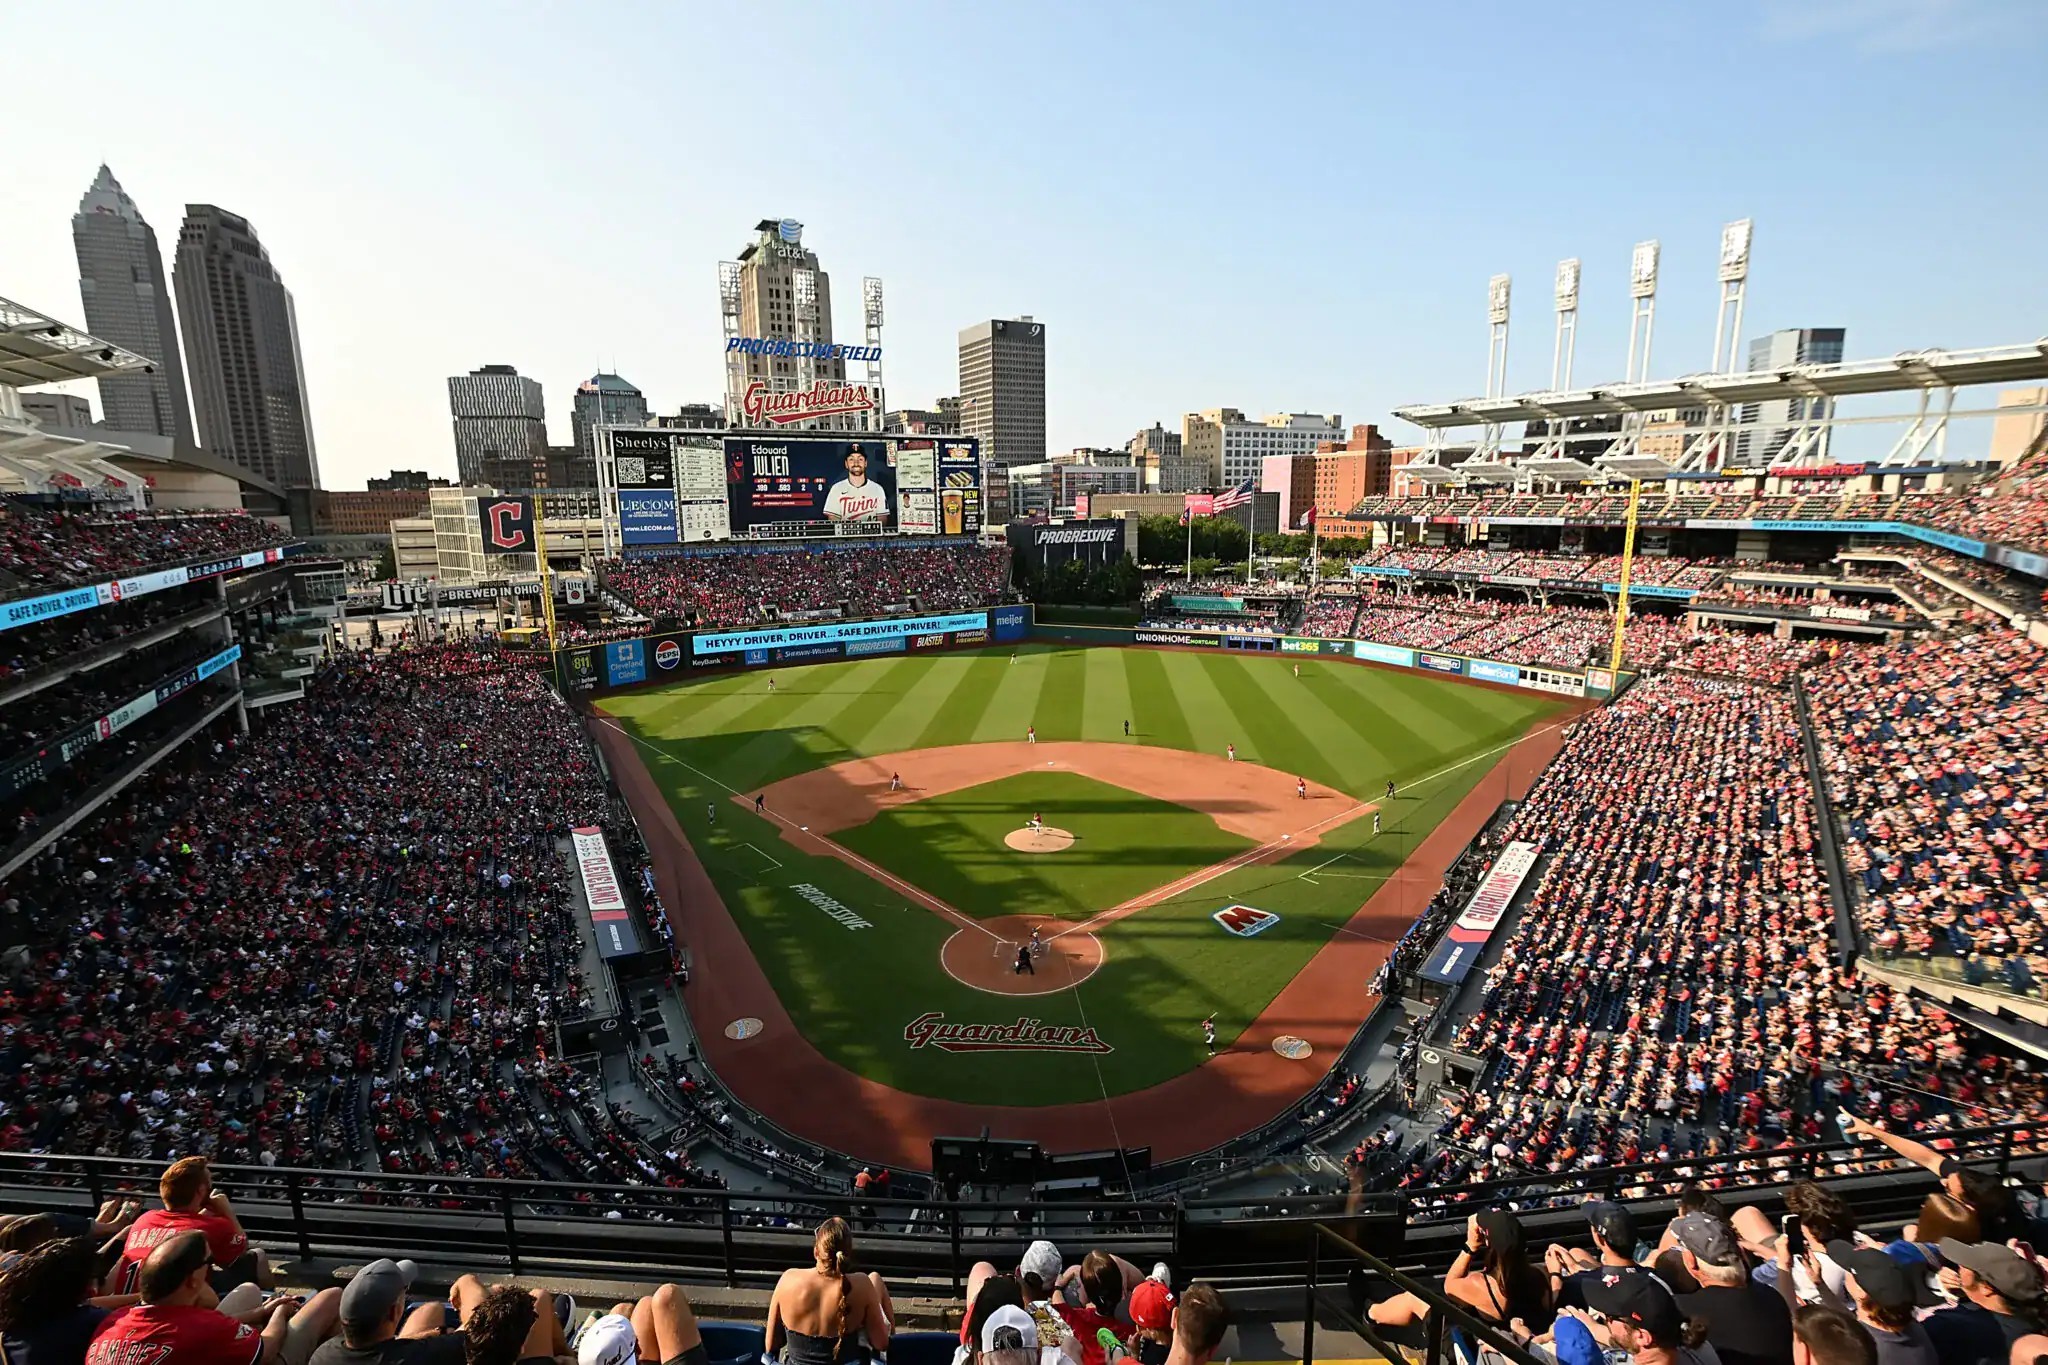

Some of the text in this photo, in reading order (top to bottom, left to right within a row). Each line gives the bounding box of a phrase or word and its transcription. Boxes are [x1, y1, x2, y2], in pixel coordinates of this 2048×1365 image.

[777, 246, 808, 261] at&t
[726, 337, 882, 361] PROGRESSIVE FIELD
[743, 379, 870, 425] Guardians
[615, 436, 668, 450] Sheely's
[751, 444, 788, 455] Edouard
[752, 455, 790, 476] JULIEN
[964, 490, 978, 499] NEW
[839, 495, 879, 516] Twins
[488, 502, 525, 548] C
[624, 524, 675, 533] www.LECOM.edu
[1037, 528, 1117, 545] PROGRESSIVE
[766, 544, 805, 552] HONDA
[448, 584, 540, 601] BREWED IN OHIO
[8, 604, 31, 621] SAFE
[32, 598, 65, 616] DRIVER,
[996, 614, 1024, 627] meijer
[705, 637, 742, 649] HEYYY
[743, 634, 787, 646] DRIVER,
[837, 627, 862, 637] SAFE
[863, 624, 902, 635] DRIVER,
[903, 621, 941, 631] DRIVER!
[916, 635, 944, 648] BLASTER
[847, 640, 902, 653] PROGRESSIVE
[1281, 640, 1319, 652] bet365
[574, 656, 591, 670] 811
[656, 651, 680, 661] PEPSI
[692, 657, 722, 667] KeyBank
[610, 660, 643, 671] Cleveland
[618, 671, 637, 680] Clinic
[582, 857, 619, 905] CLEVELAND
[1465, 871, 1521, 923] GUARDIANS
[788, 883, 874, 931] PROGRESSIVE
[904, 1011, 1103, 1050] Guardians
